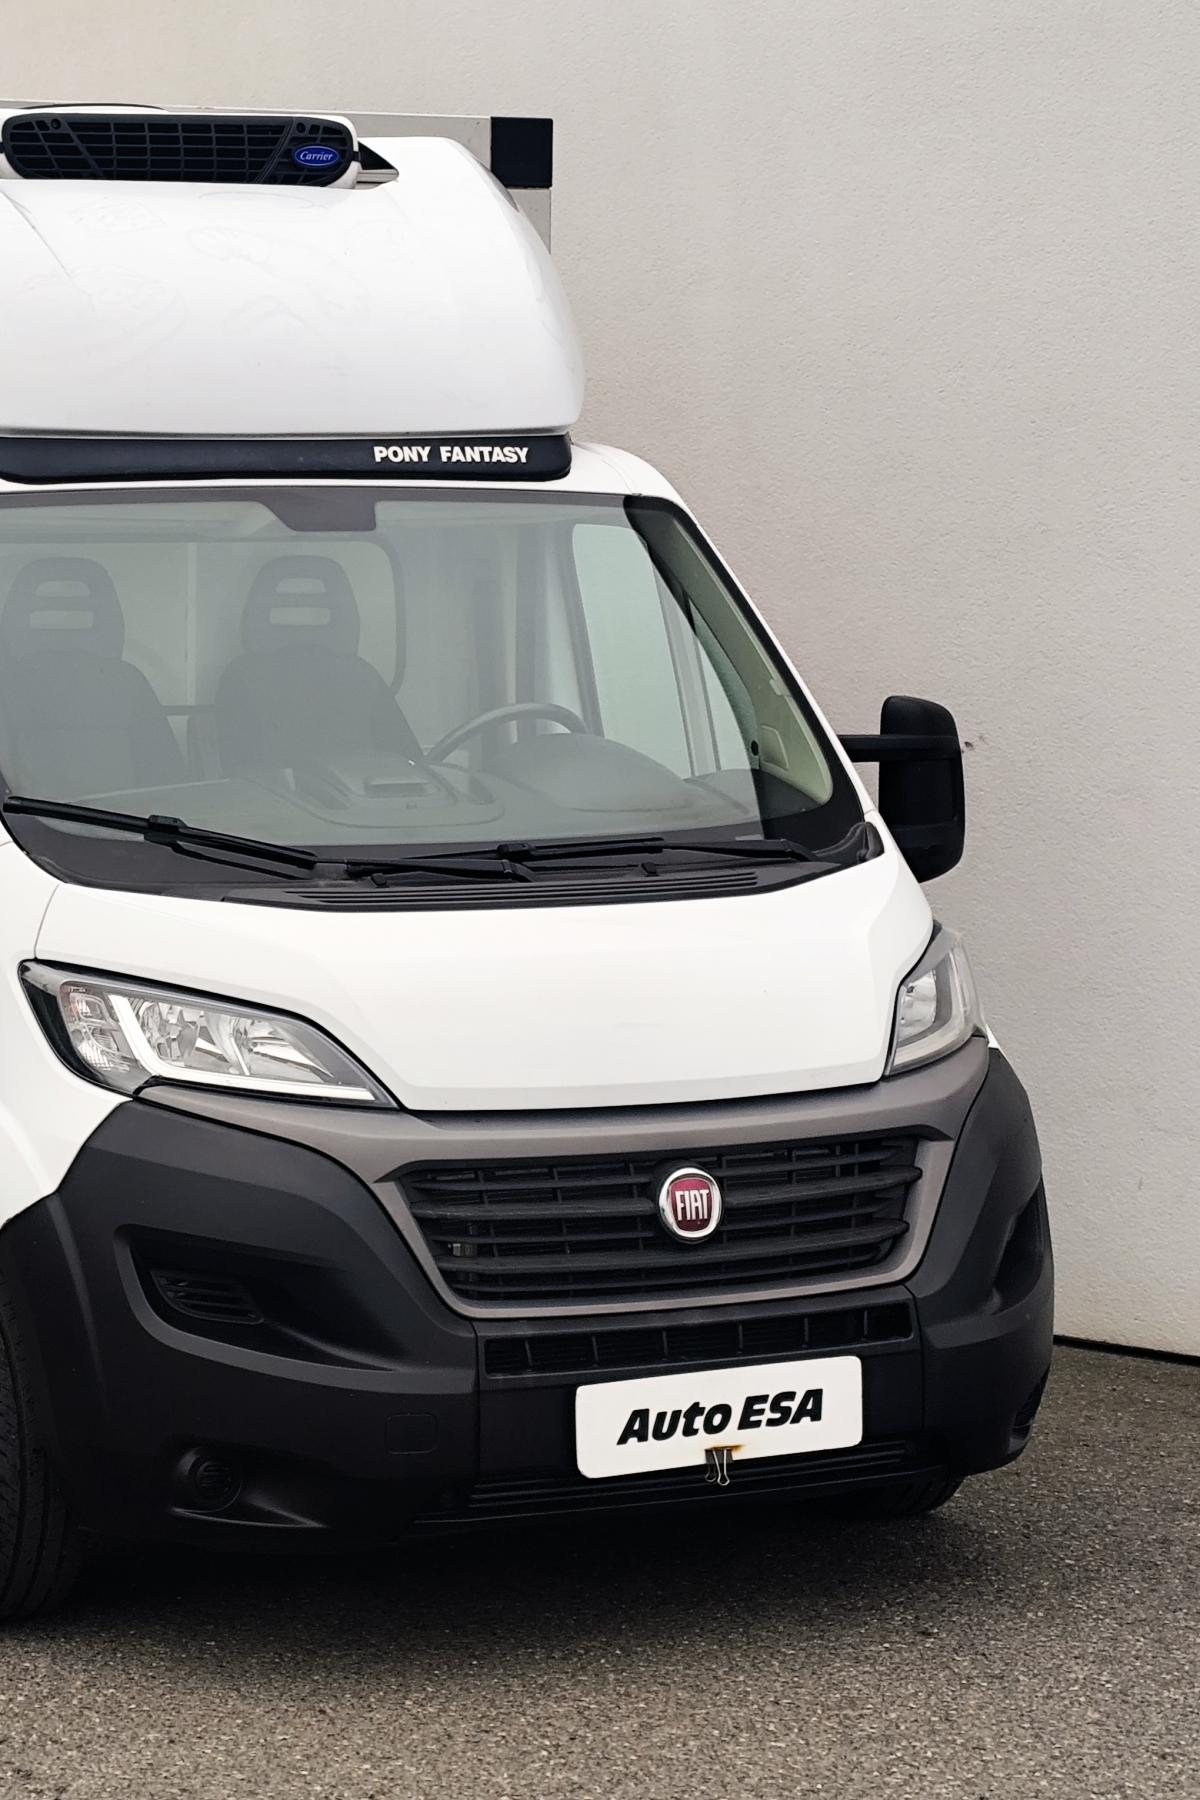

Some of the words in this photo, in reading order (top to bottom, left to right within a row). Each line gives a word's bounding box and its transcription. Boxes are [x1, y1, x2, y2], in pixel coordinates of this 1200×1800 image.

[300, 151, 333, 161] Carrier
[373, 446, 431, 463] PONY
[439, 446, 529, 463] FANTASY
[675, 1189, 709, 1221] FIAT
[616, 1402, 732, 1445] Auto
[737, 1388, 823, 1430] ESA
